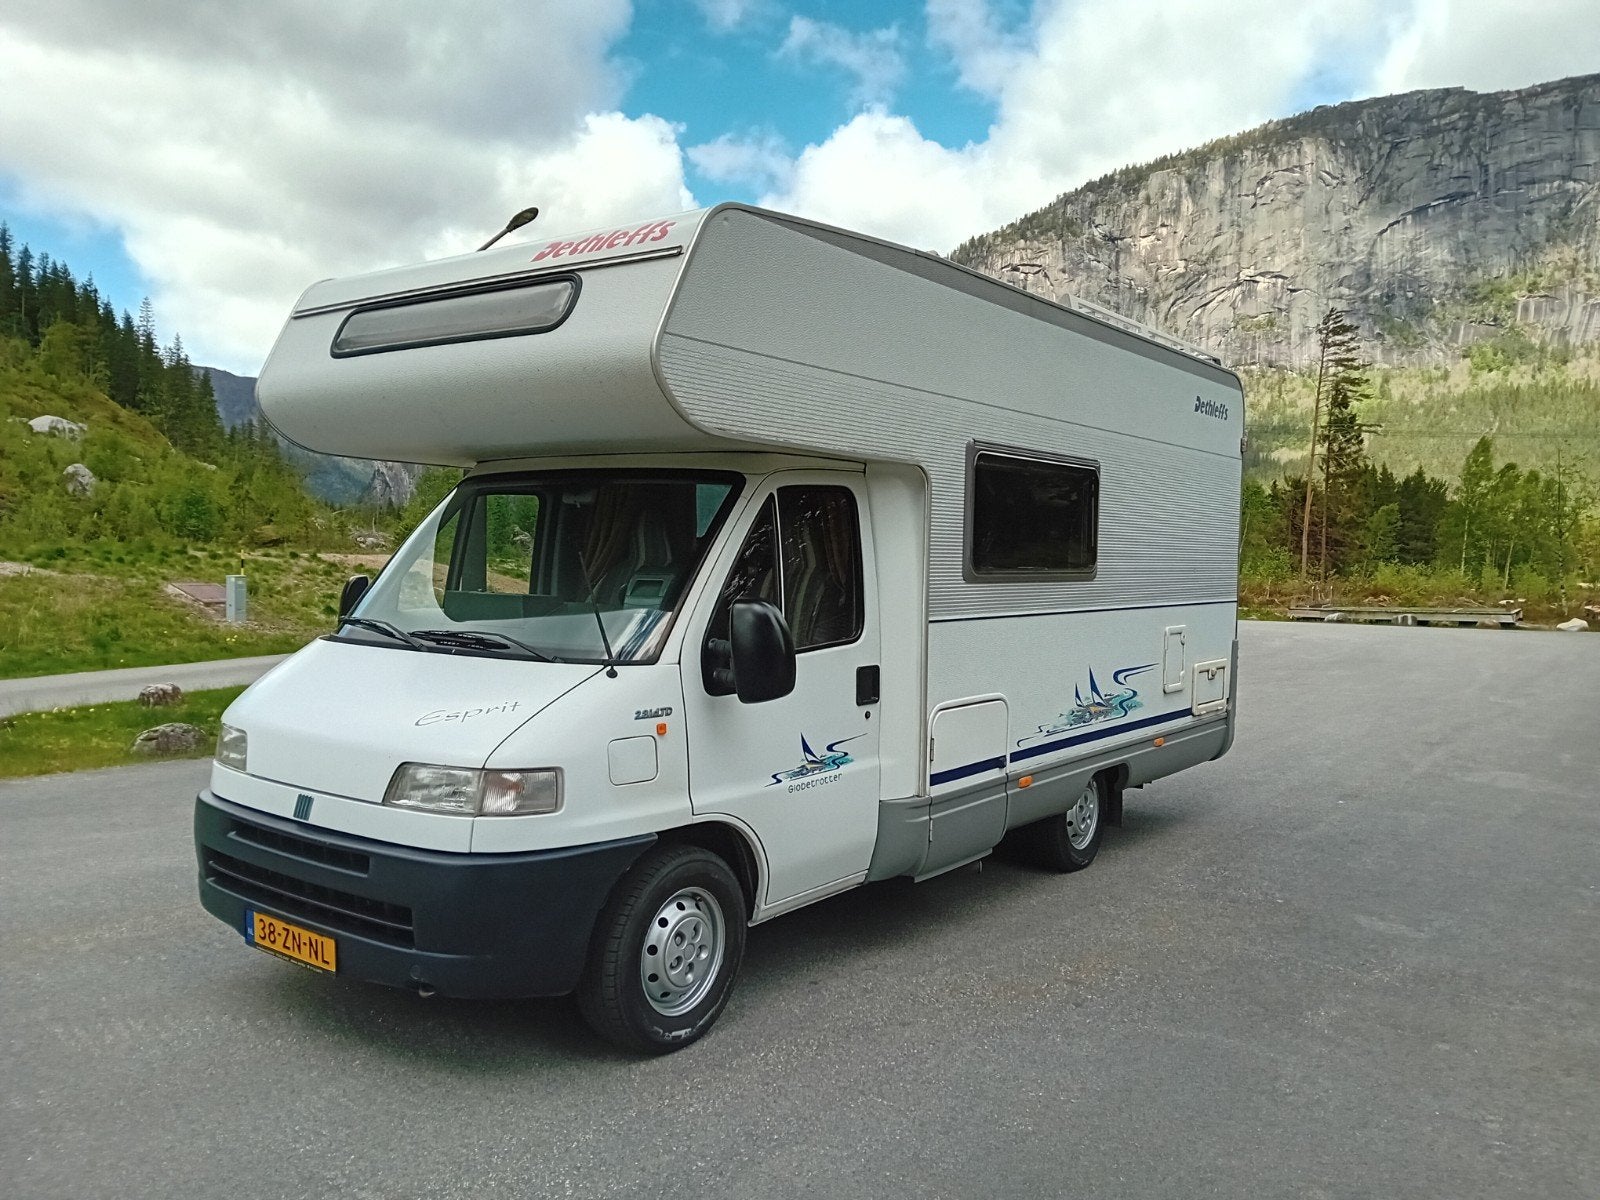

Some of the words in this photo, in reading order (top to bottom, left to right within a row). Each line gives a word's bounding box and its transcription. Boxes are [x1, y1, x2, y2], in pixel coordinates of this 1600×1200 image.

[530, 220, 677, 262] Dethleffs
[1194, 395, 1228, 421] Dethleffs
[414, 701, 521, 726] Esprit
[788, 773, 842, 793] Globetrotter
[258, 918, 330, 965] 38-ZN-NL
